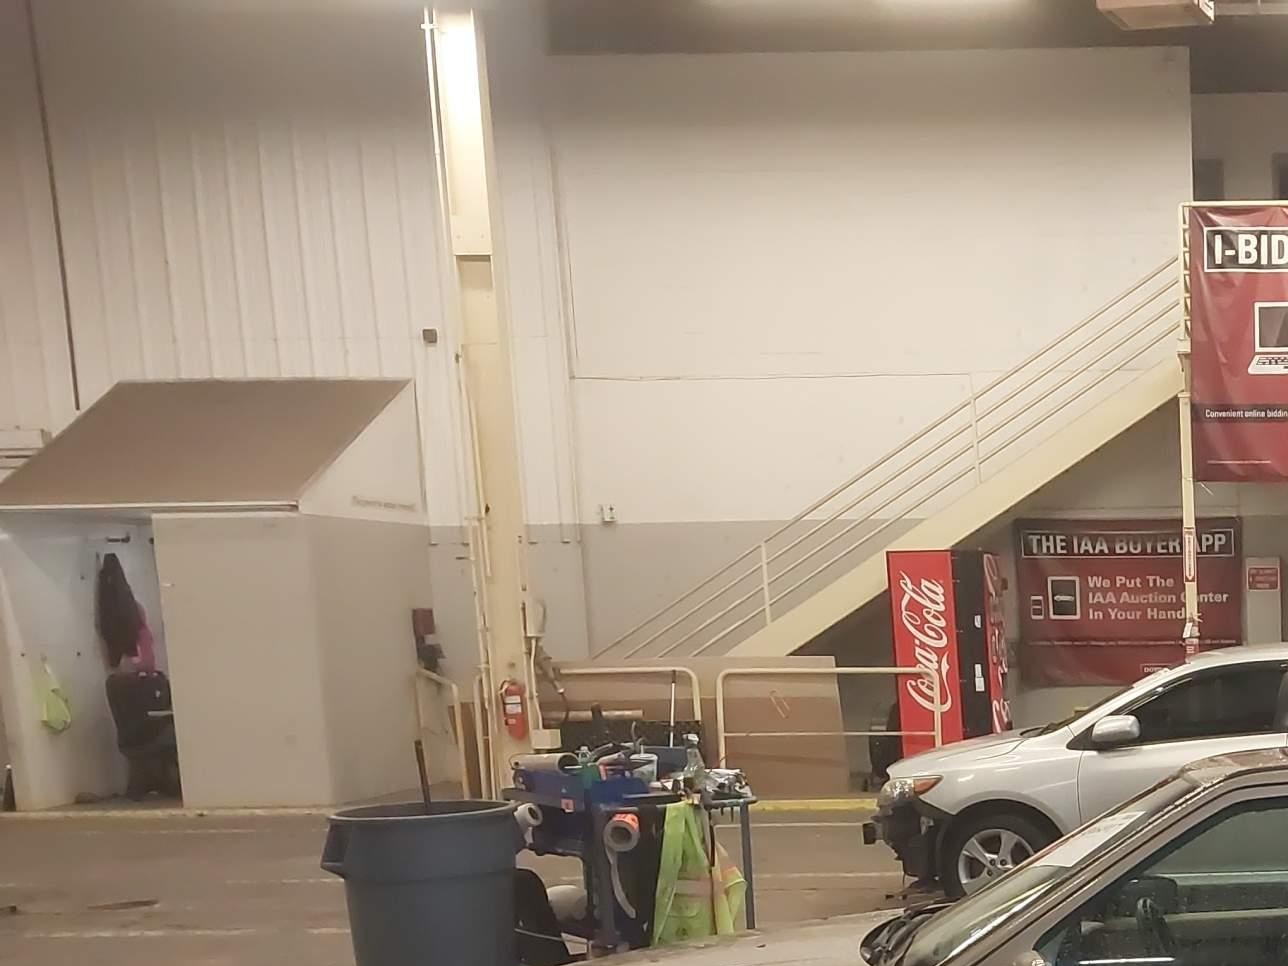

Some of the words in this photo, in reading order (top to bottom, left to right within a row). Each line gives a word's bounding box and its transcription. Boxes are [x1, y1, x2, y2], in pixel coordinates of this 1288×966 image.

[1205, 408, 1244, 418] Convenient
[1244, 408, 1266, 418] online
[1028, 534, 1068, 554] THE
[1072, 534, 1109, 554] IAA
[1087, 575, 1111, 589] We
[1115, 575, 1142, 588] Put
[1146, 575, 1175, 588] The
[1088, 591, 1118, 604] IAA
[1120, 591, 1177, 604] Auction
[1088, 607, 1103, 620] In
[1107, 607, 1142, 620] Your
